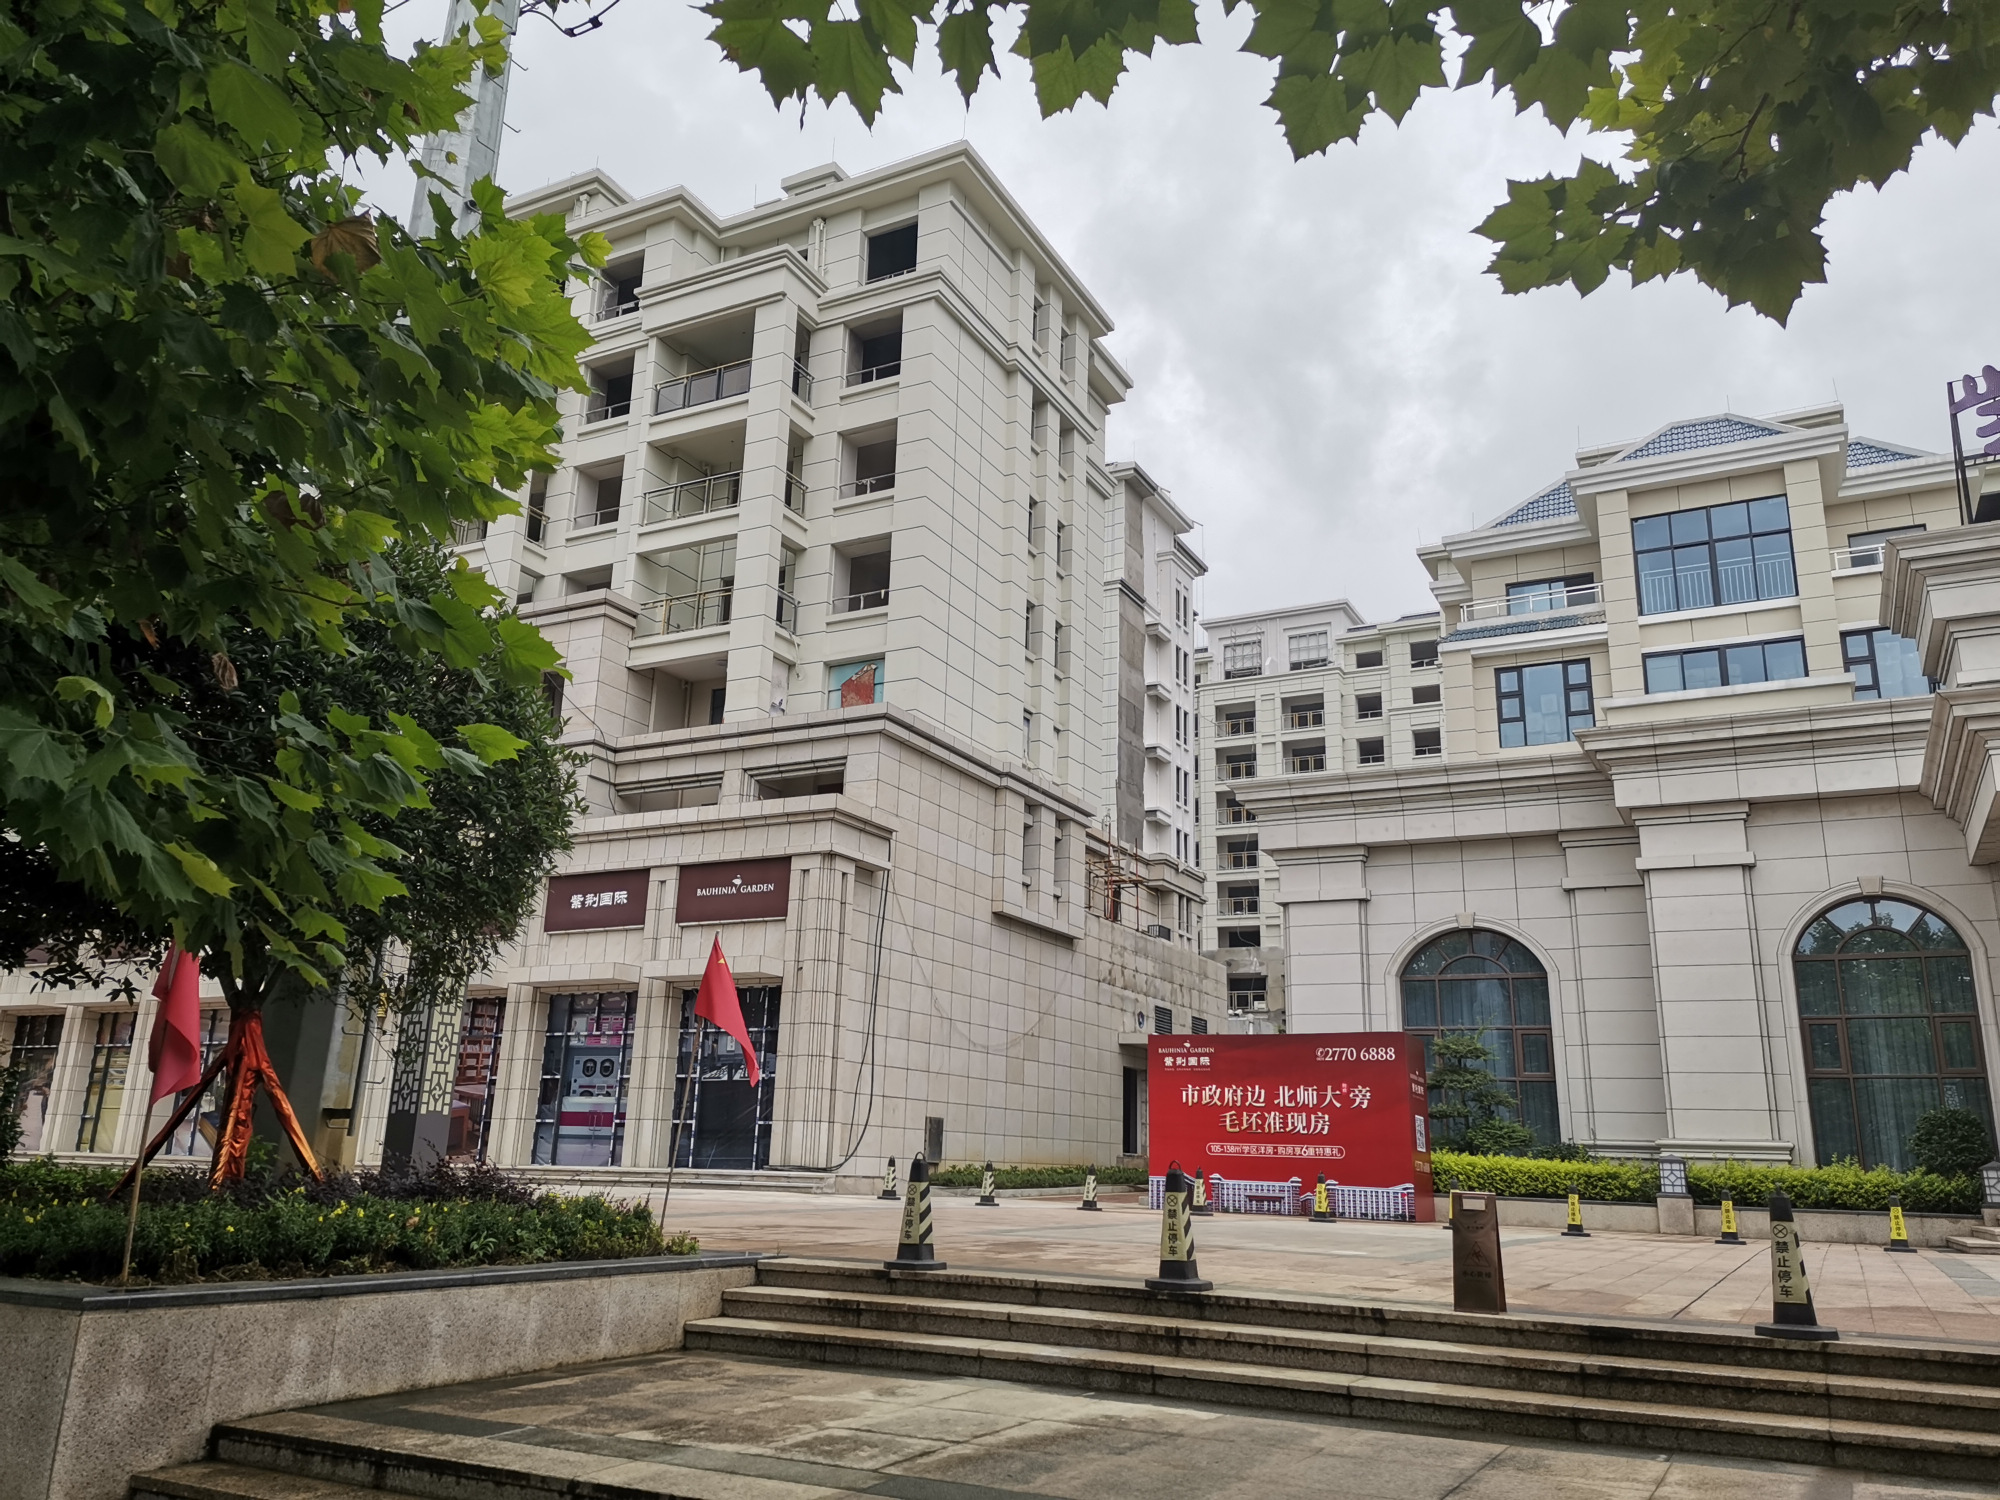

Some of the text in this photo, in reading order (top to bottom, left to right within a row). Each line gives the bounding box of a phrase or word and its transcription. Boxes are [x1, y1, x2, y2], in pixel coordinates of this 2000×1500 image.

[570, 891, 628, 909] 紫荆国际
[696, 883, 775, 897] BAUHINIA GARDEN
[1164, 1056, 1211, 1067] 紫荆国际
[1324, 1047, 1396, 1061] 2770 6888
[1180, 1084, 1266, 1108] 市政府边
[1218, 1111, 1331, 1135] 毛坯准现房
[903, 1197, 916, 1240] 禁止停车
[1167, 1208, 1178, 1256] 禁止停车
[1774, 1240, 1794, 1298] 禁止停车
